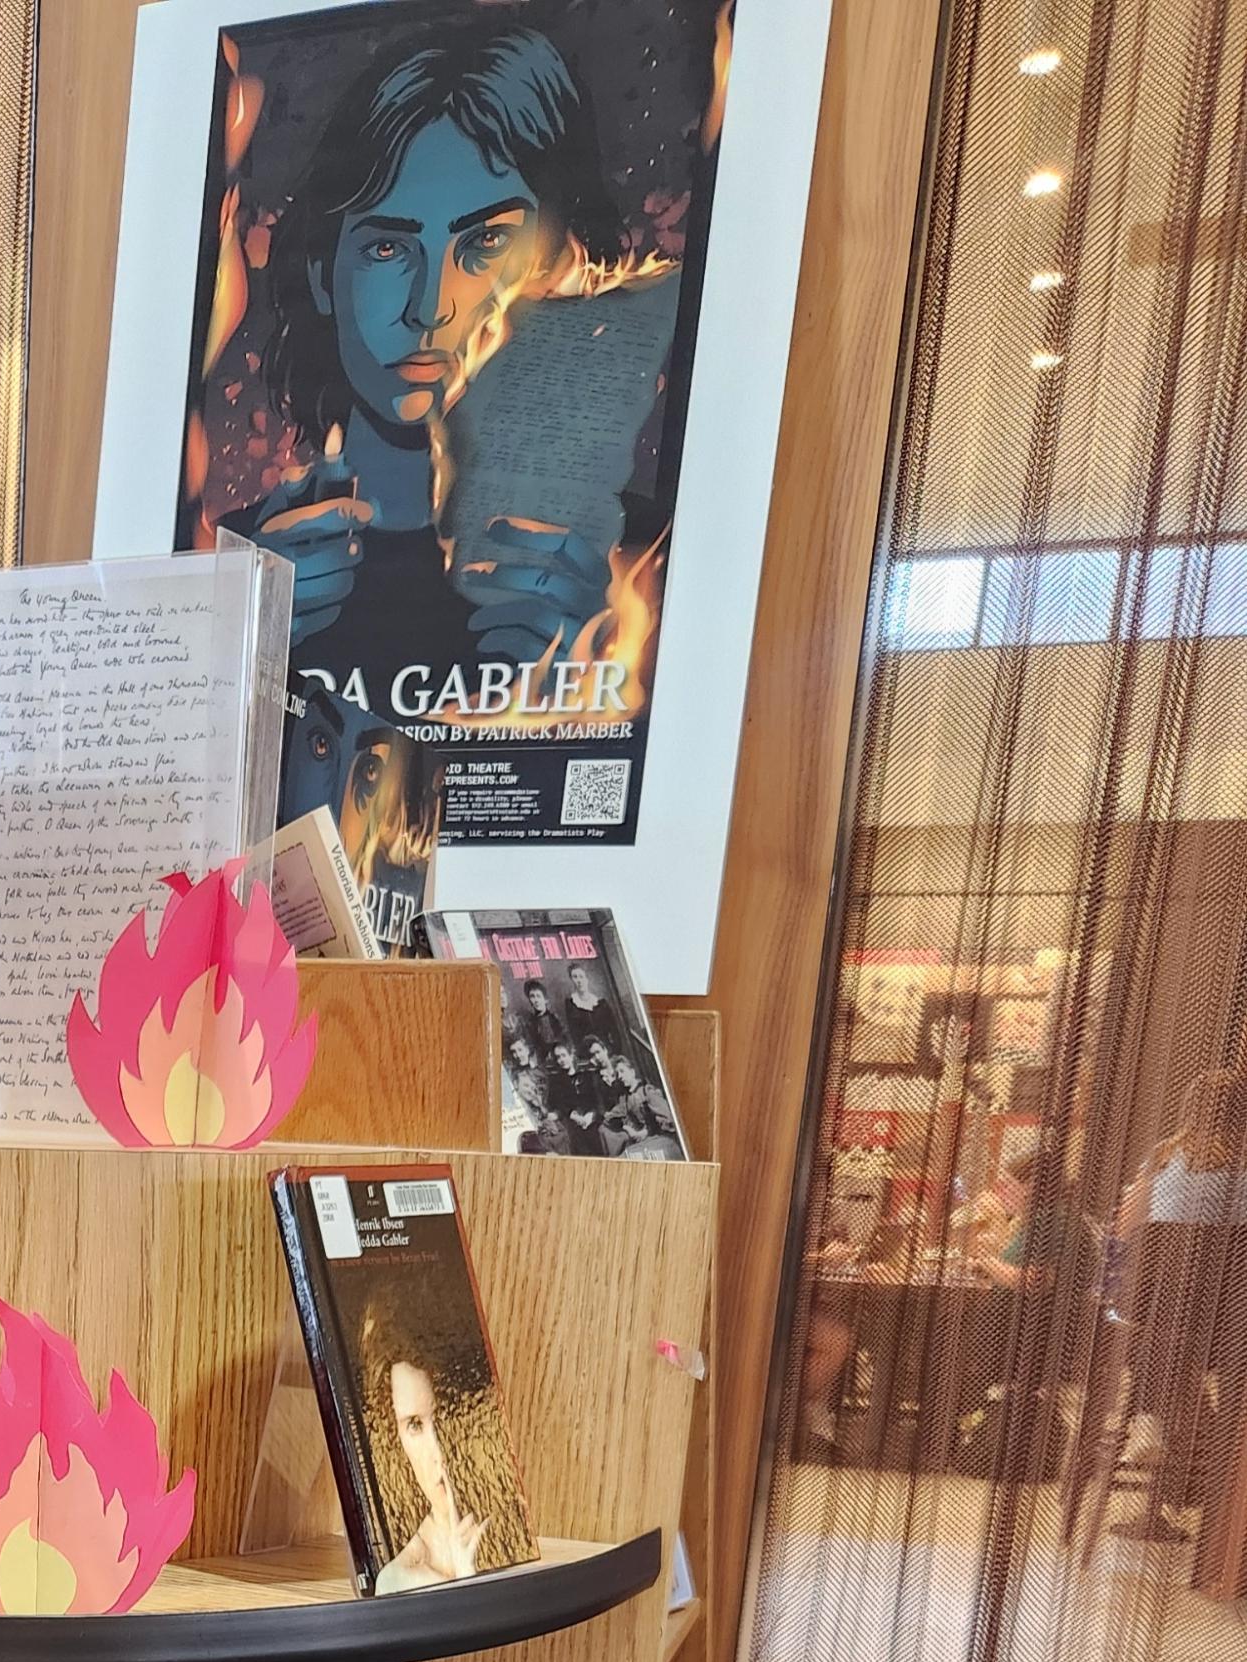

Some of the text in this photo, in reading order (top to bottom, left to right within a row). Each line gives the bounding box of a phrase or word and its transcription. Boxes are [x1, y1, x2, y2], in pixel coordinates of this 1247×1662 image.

[391, 660, 630, 716] GABLER
[450, 722, 633, 742] BY PATRICK MARBER
[468, 763, 512, 773] THEATRE
[587, 829, 605, 837] Play
[332, 844, 376, 959] Victorian Fashions
[382, 1218, 404, 1230] Ibsen
[382, 1234, 409, 1246] Gabler
